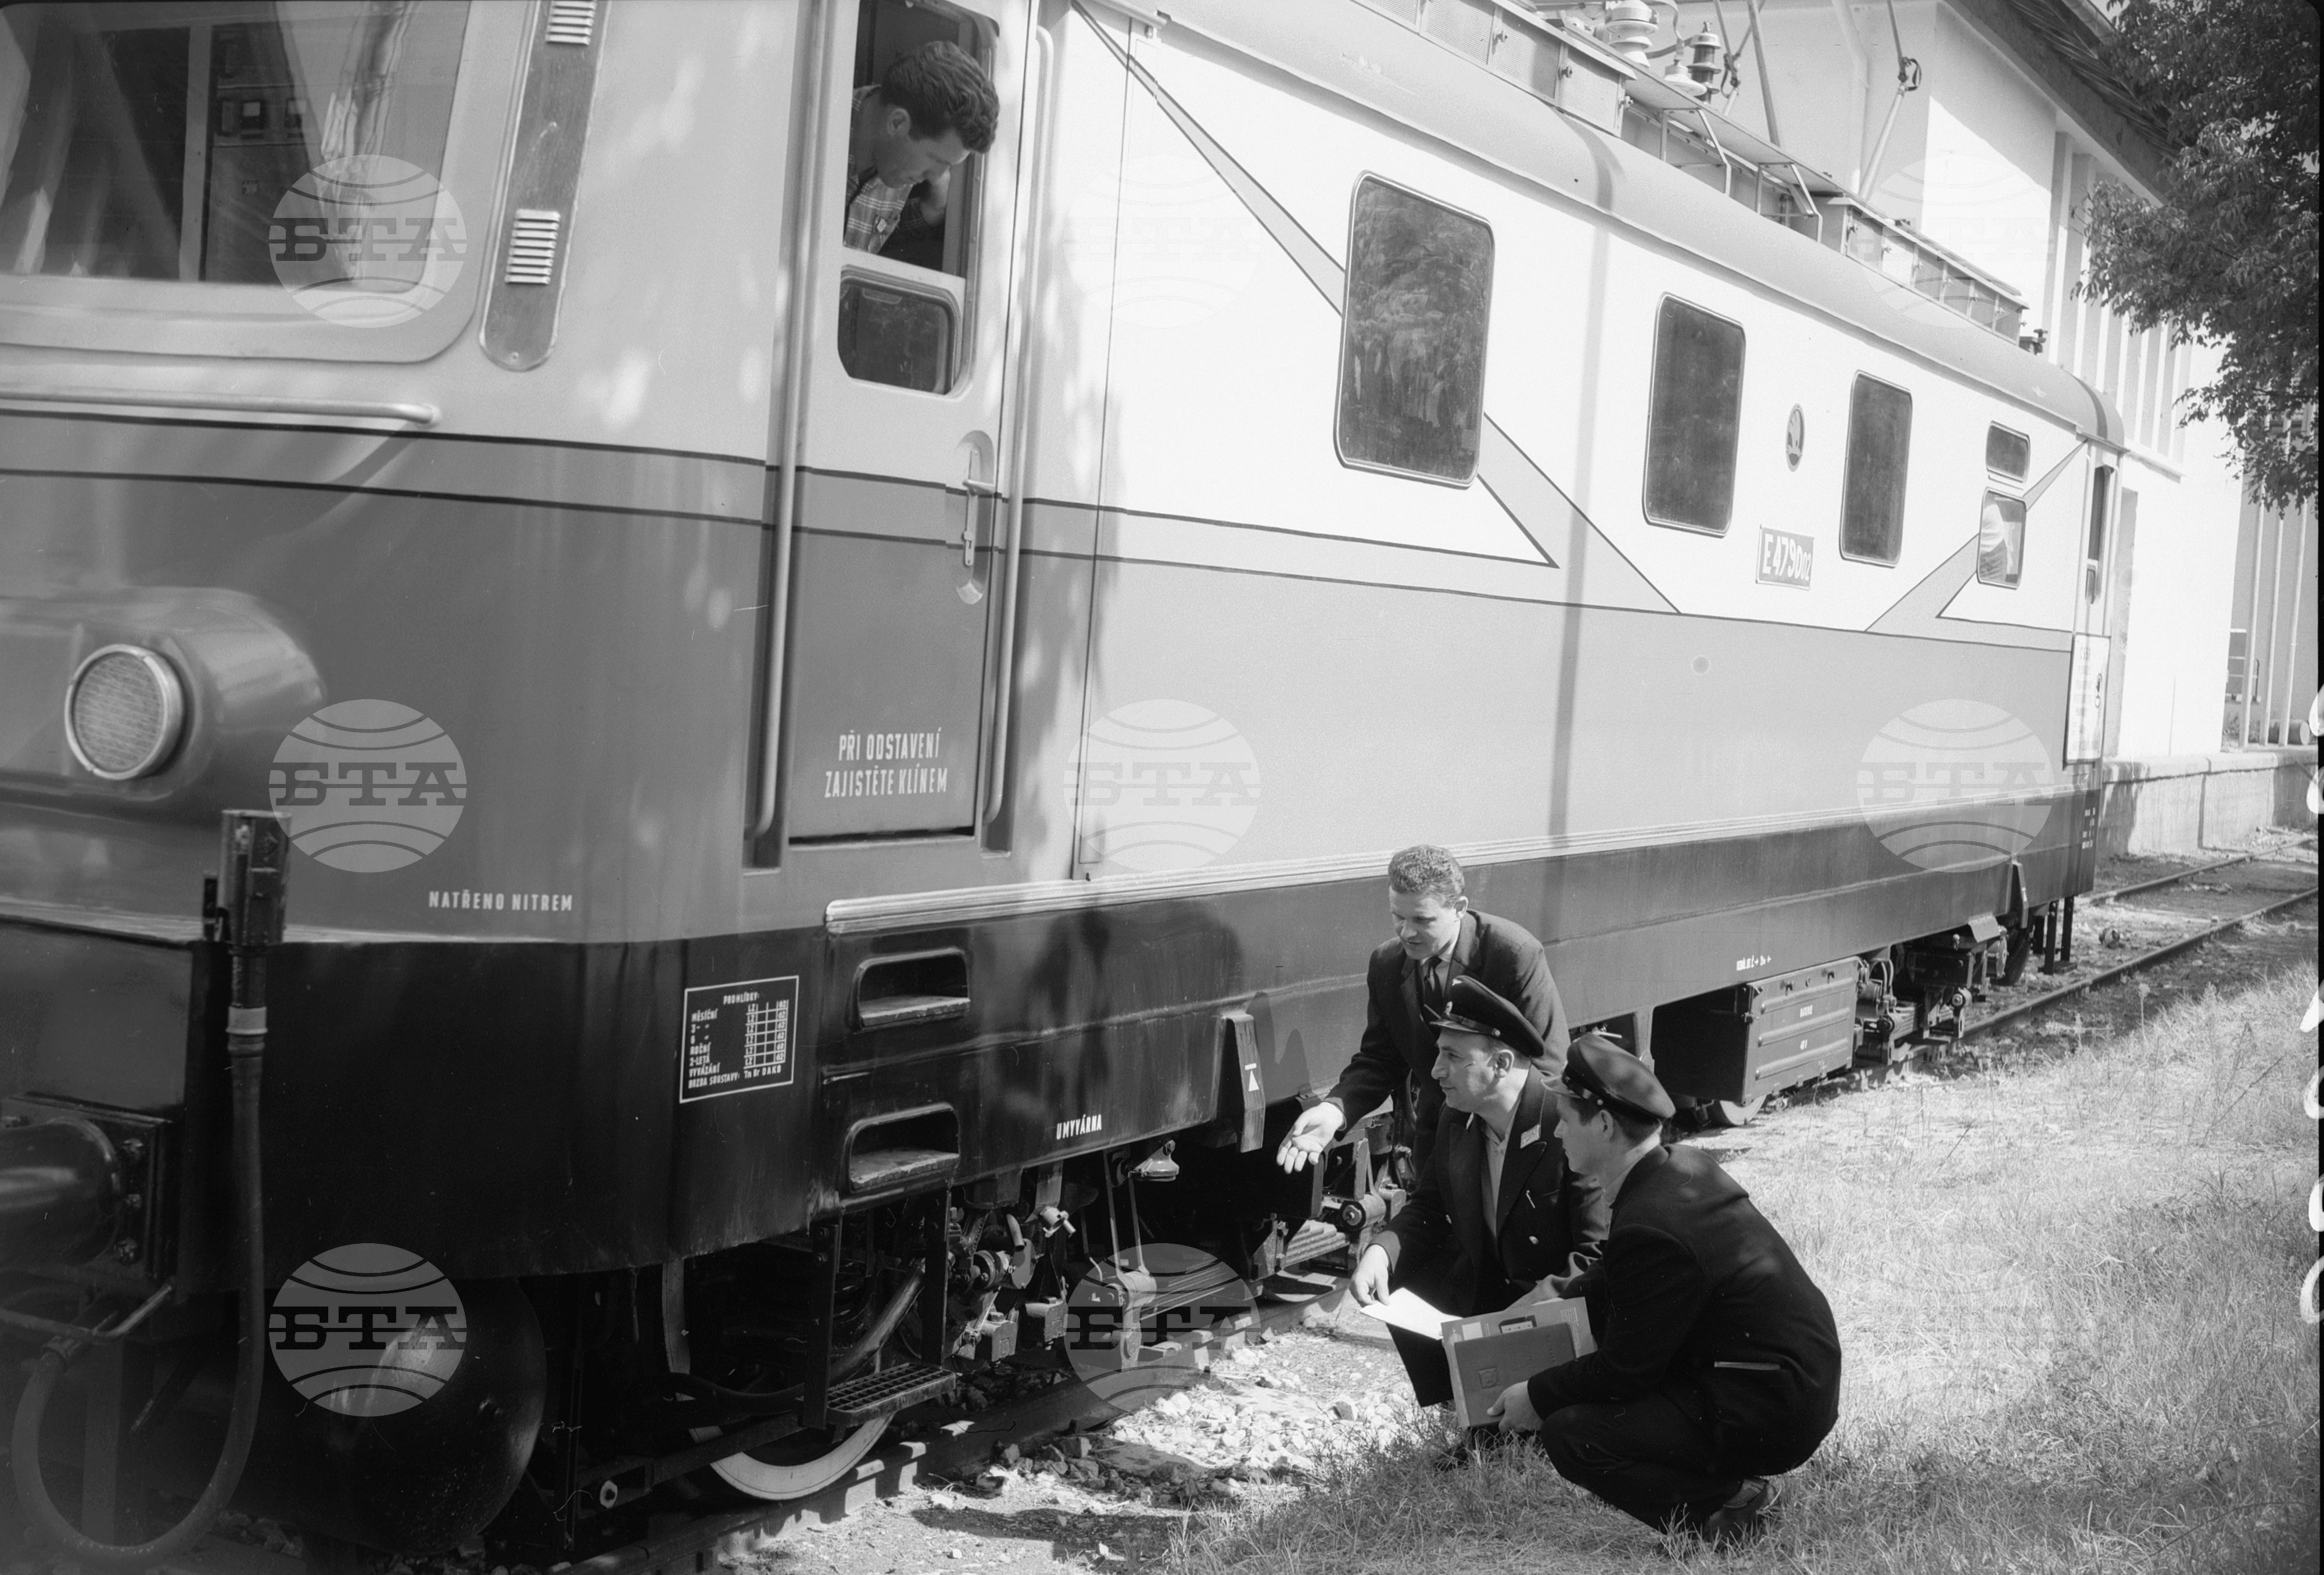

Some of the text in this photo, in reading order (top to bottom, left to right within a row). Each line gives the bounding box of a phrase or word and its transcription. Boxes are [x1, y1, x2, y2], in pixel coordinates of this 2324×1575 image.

[838, 727, 942, 761] PŘI ODSTAVENÍ
[824, 763, 948, 798] ZAJISTĚTE KLÍNEM
[429, 889, 573, 911] NATŘENO NITREM
[748, 1004, 755, 1012] LZ
[747, 1014, 755, 1023] LZ
[747, 1025, 754, 1033] LZ
[746, 1036, 754, 1044] LZ
[745, 1046, 753, 1055] LZ
[745, 1057, 752, 1065] LZ
[762, 1065, 781, 1076] DAKO
[1056, 1114, 1102, 1140] UMYVÁRNA
